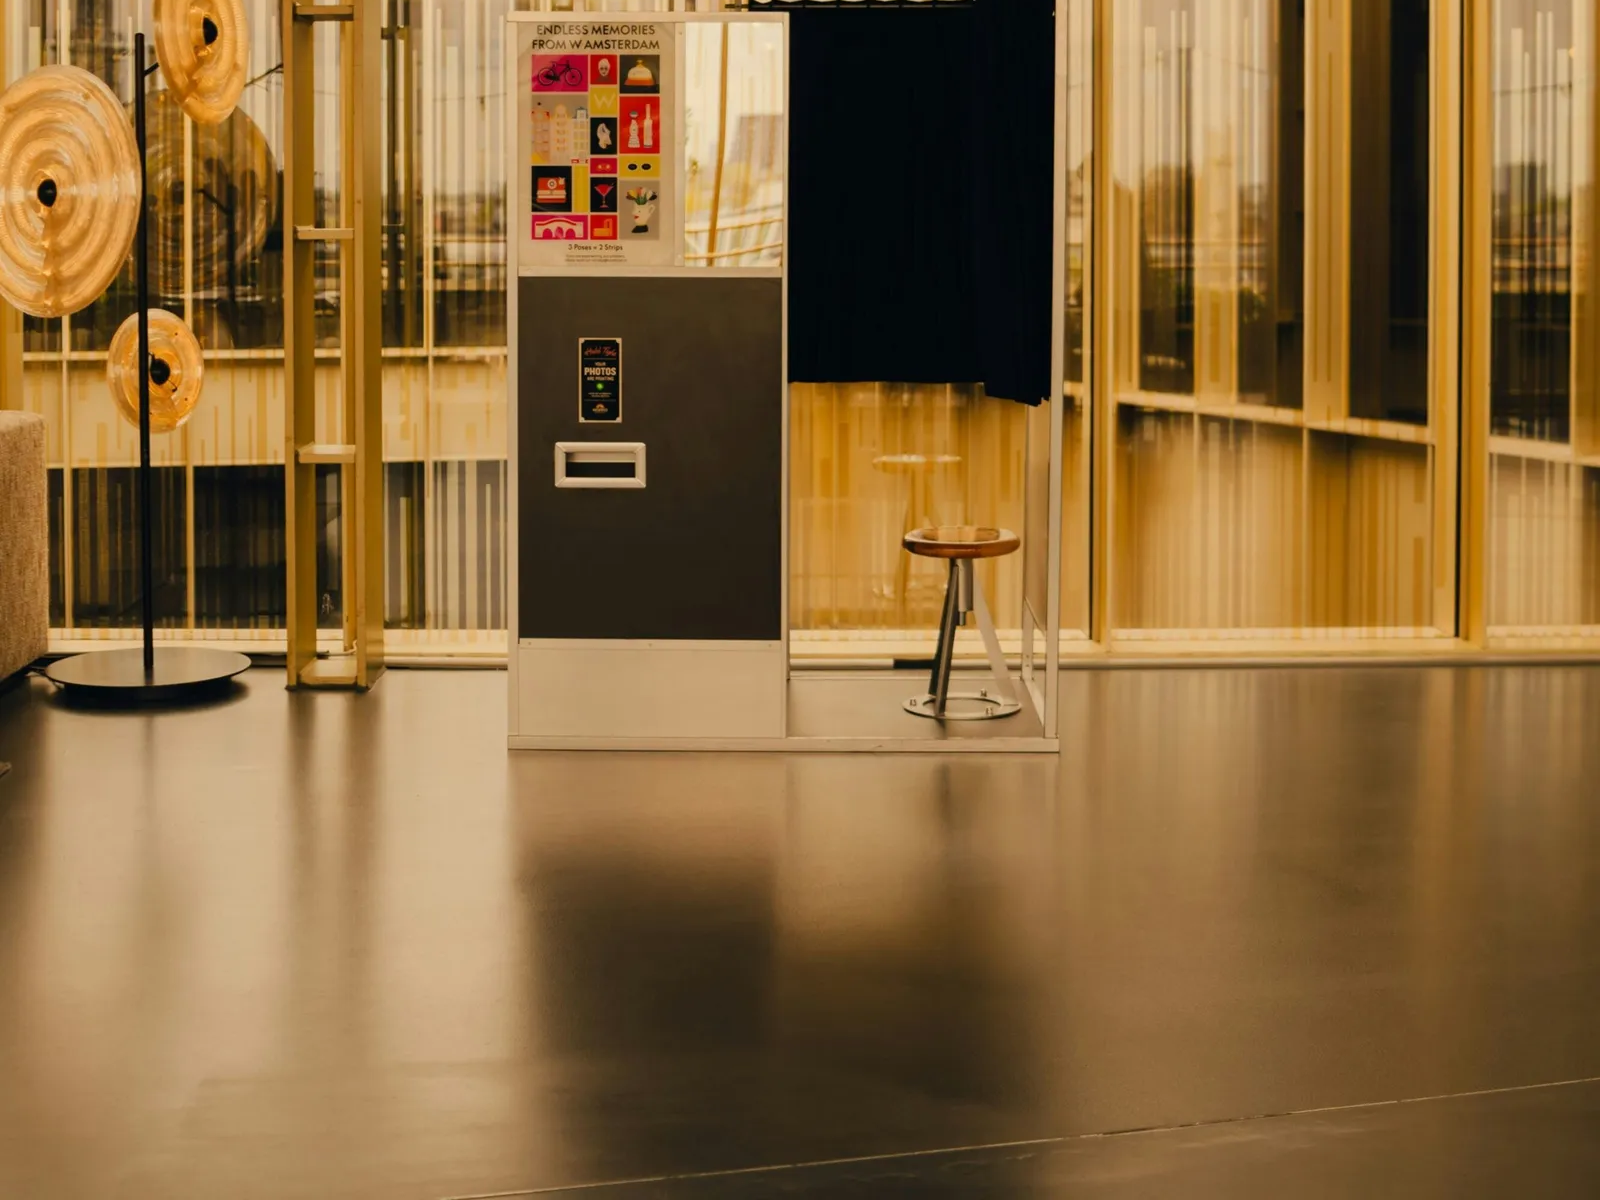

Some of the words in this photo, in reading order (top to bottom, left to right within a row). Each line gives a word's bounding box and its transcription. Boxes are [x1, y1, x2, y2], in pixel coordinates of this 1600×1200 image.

[536, 24, 589, 36] ENDLESS
[591, 24, 656, 36] MEMORIES
[531, 39, 567, 50] FROM
[569, 39, 582, 50] W
[583, 39, 660, 50] AMSTERDAM
[604, 243, 623, 252] Strips
[584, 367, 617, 376] PHOTOS
